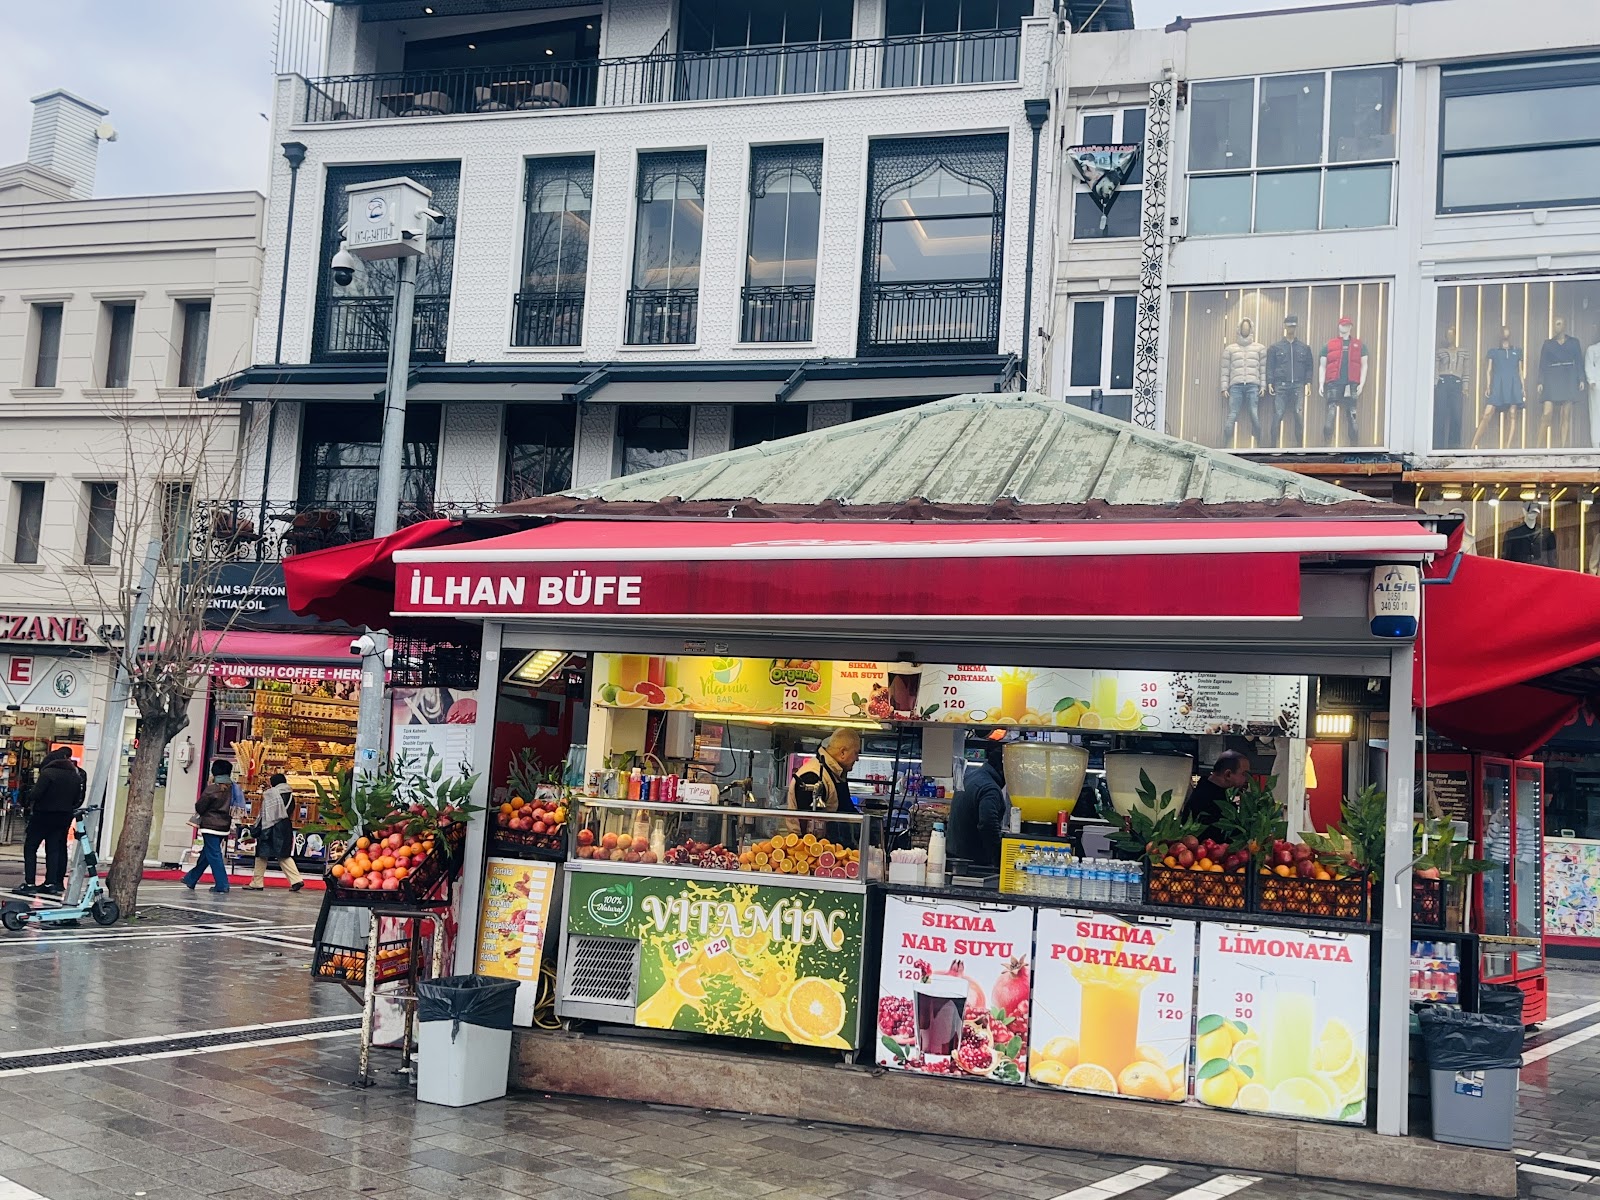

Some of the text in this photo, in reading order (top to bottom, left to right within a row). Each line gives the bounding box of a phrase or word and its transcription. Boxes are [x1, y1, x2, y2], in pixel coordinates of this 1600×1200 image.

[233, 585, 286, 596] SAFFRON
[410, 569, 642, 606] İLHAN BÜFE
[246, 601, 266, 610] OIL
[1381, 601, 1408, 610] 340 50 10
[10, 657, 32, 682] E
[221, 664, 275, 677] TURKISH
[277, 667, 325, 679] COFFEE
[957, 664, 988, 672] SIKMA
[771, 669, 819, 683] Organic
[947, 674, 996, 682] PORTAKAL
[700, 674, 750, 697] Vitamin
[943, 686, 957, 695] 70
[1140, 682, 1157, 692] 30
[716, 695, 733, 703] BAR
[784, 689, 798, 698] 70
[784, 701, 805, 711] 120
[943, 699, 965, 709] 120
[1141, 698, 1158, 708] 50
[35, 706, 75, 714] FARMACIA
[603, 895, 623, 904] 100%
[596, 903, 625, 913] Natural
[641, 890, 846, 952] VİTAMİN
[921, 911, 996, 933] SIKMA
[1076, 921, 1156, 945] SIKMA
[674, 941, 690, 954] 70
[707, 939, 728, 955] 120
[901, 933, 1014, 958] NAR SUYU
[1218, 933, 1353, 963] LİMONATA
[898, 955, 914, 965] 70
[1050, 944, 1177, 973] PORTAKAL
[898, 970, 921, 981] 120
[1157, 992, 1175, 1003] 70
[1235, 992, 1253, 1003] 30
[1157, 1009, 1184, 1020] 120
[1235, 1008, 1253, 1019] 50
